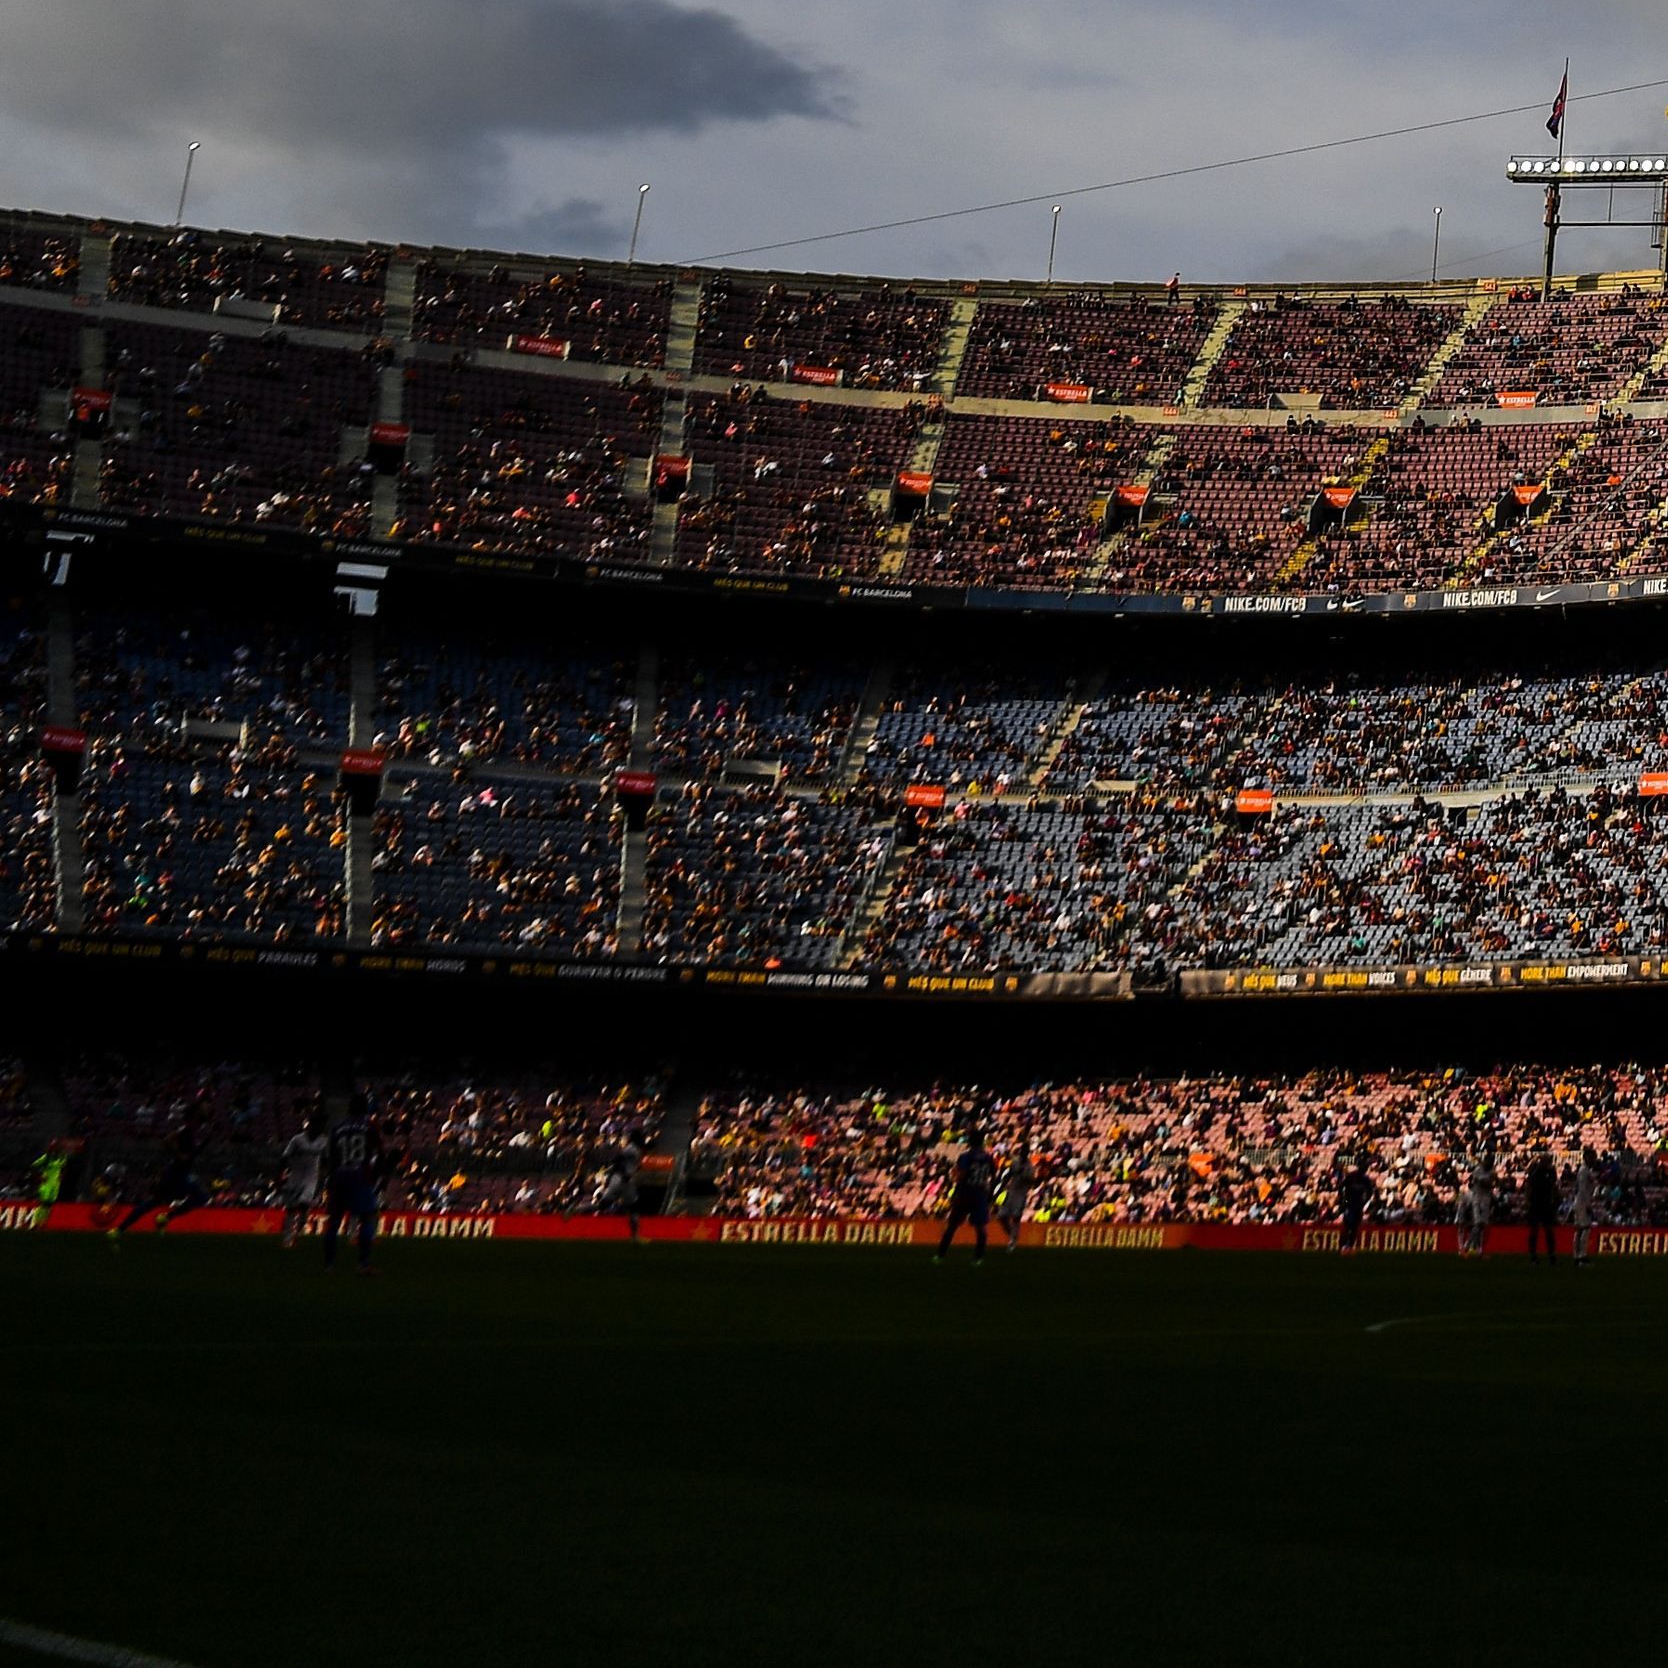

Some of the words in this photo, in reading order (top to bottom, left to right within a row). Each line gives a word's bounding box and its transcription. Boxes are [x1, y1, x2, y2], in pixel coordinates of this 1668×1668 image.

[863, 588, 912, 600] BARCELONA
[1224, 596, 1306, 613] NIKE.COM/FCB
[1443, 589, 1518, 608] NIKE.COM/FCB
[337, 1135, 366, 1163] 18
[413, 1216, 496, 1239] DAMM
[721, 1221, 836, 1244] ESTRELLA
[844, 1222, 913, 1245] DAMM
[1045, 1226, 1114, 1249] ESTRELLA
[1115, 1226, 1164, 1249] DAMM
[1384, 1229, 1439, 1252] DAMM
